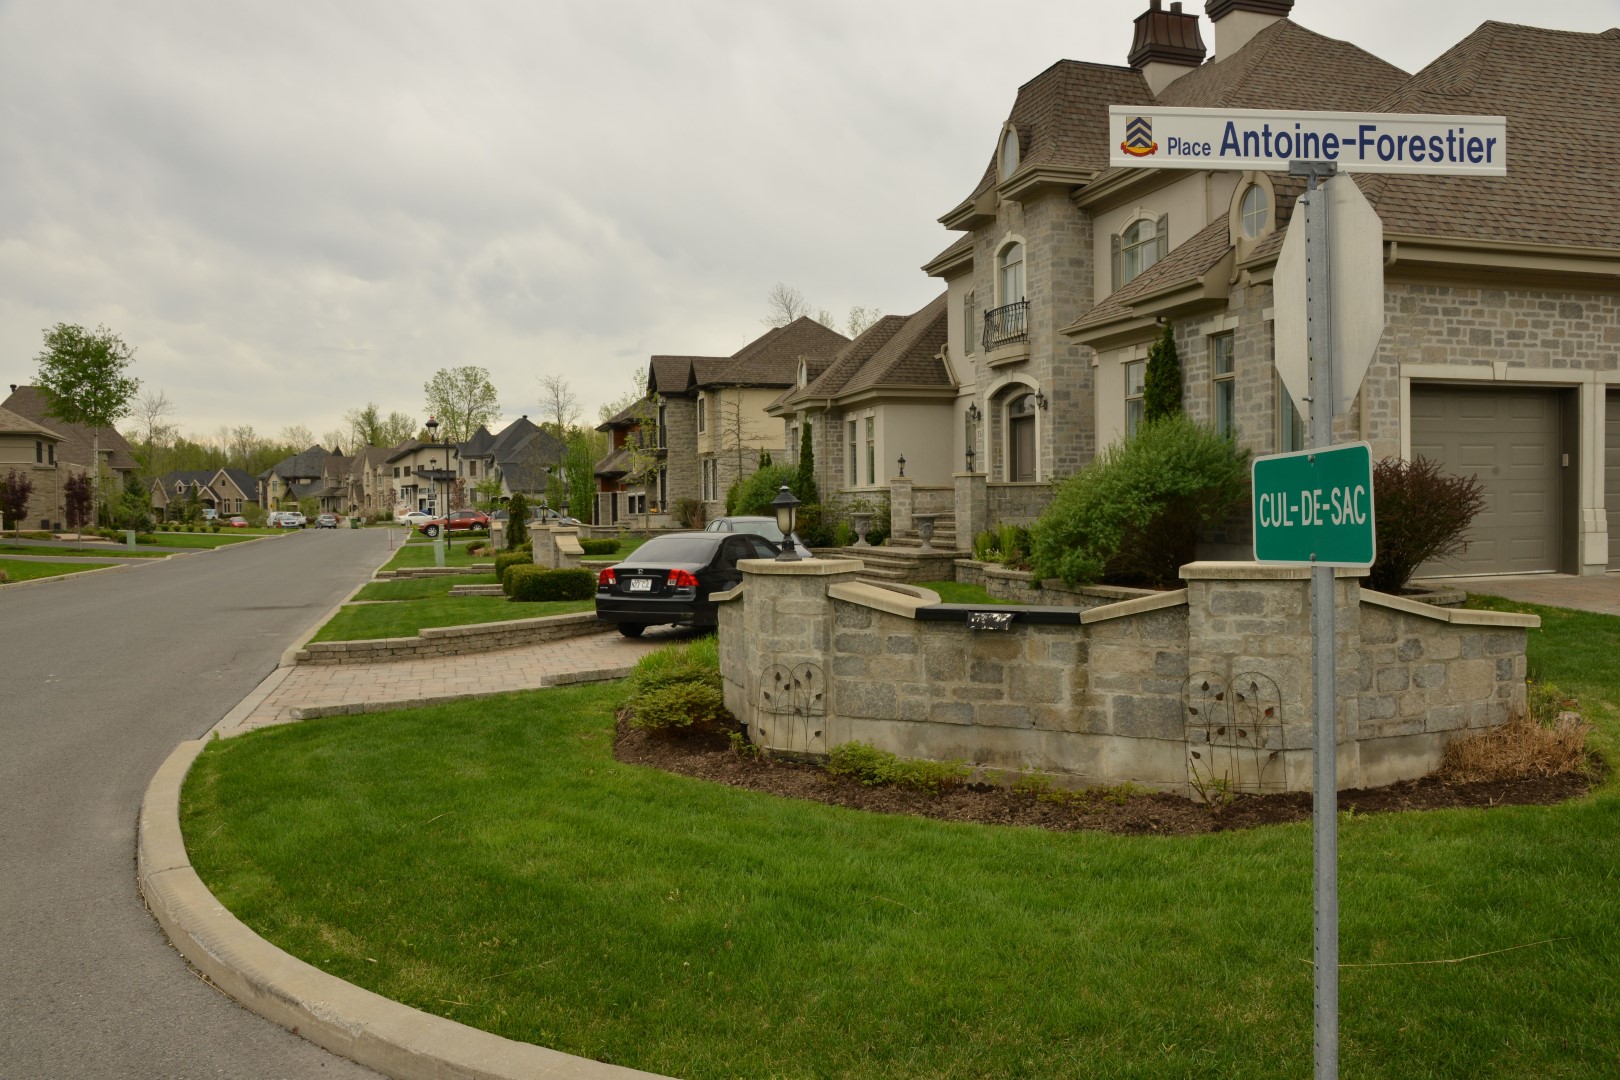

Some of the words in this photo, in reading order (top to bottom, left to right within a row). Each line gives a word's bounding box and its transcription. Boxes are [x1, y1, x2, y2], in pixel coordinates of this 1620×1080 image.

[1168, 137, 1211, 157] Place
[1219, 121, 1497, 164] Antoine-Forestier
[1259, 484, 1366, 528] CUL-DE-SAC
